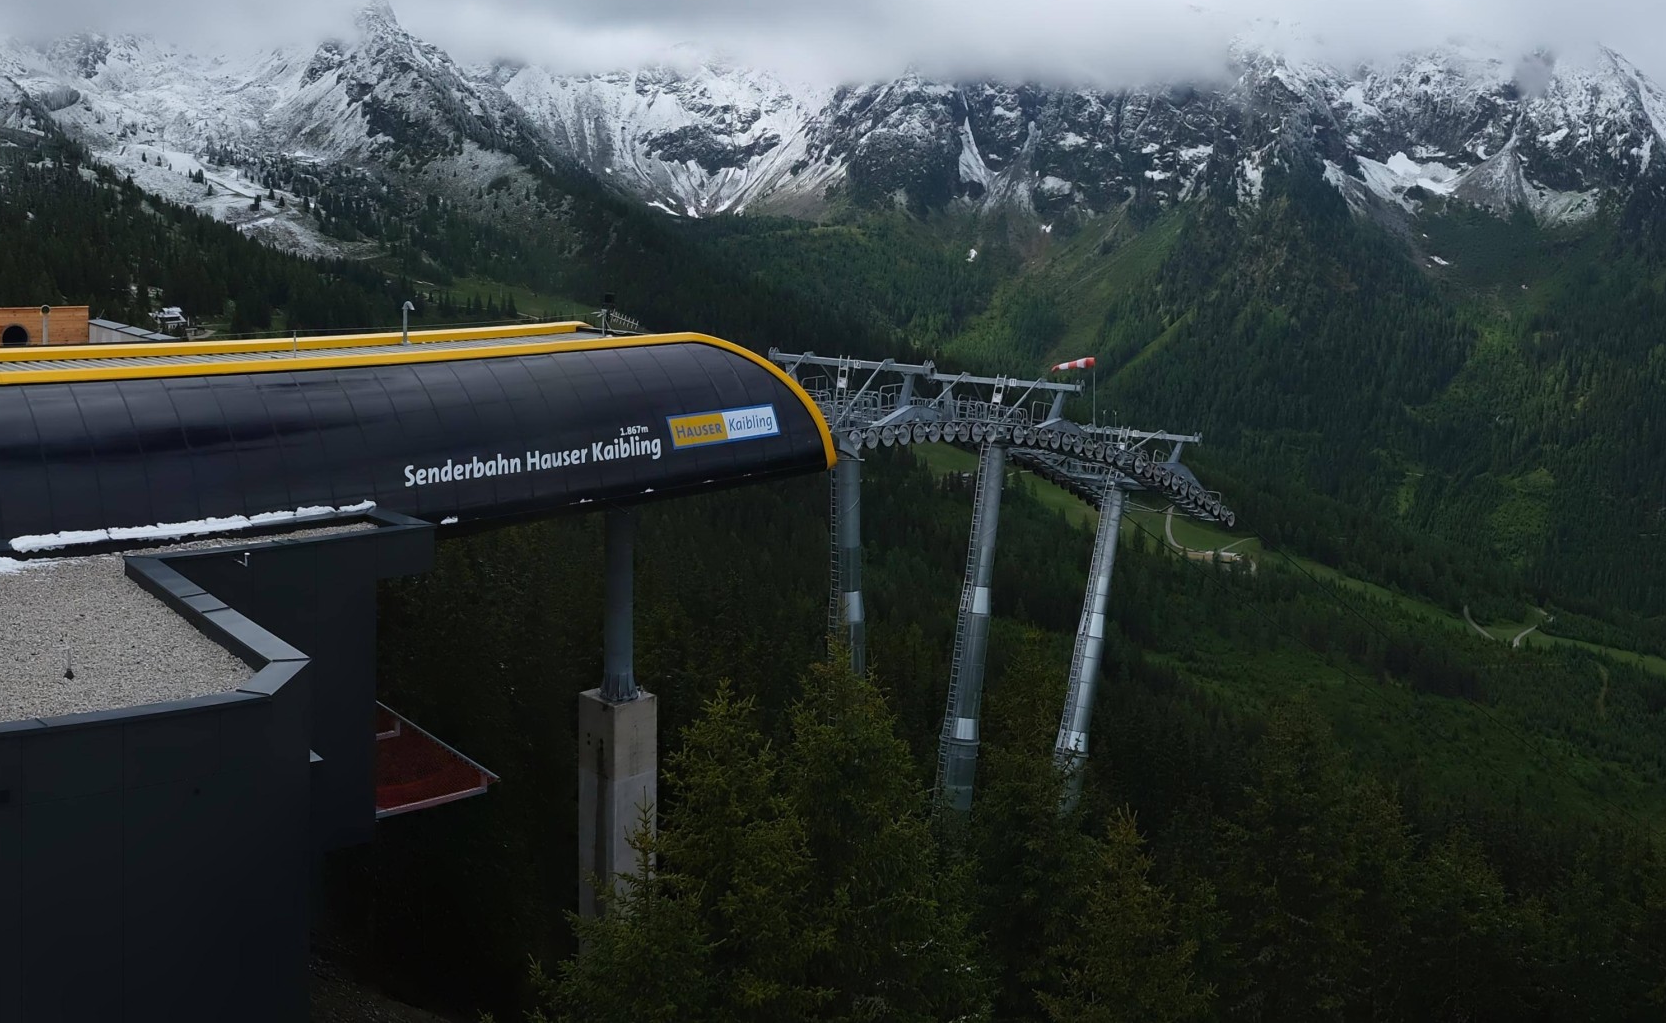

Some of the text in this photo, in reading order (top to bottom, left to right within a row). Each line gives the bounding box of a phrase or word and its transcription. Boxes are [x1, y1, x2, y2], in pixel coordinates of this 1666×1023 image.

[620, 426, 649, 436] 1.867m
[674, 415, 773, 439] HAUSER Kaibling
[404, 436, 662, 487] Senderbahn Hauser Kaibling
